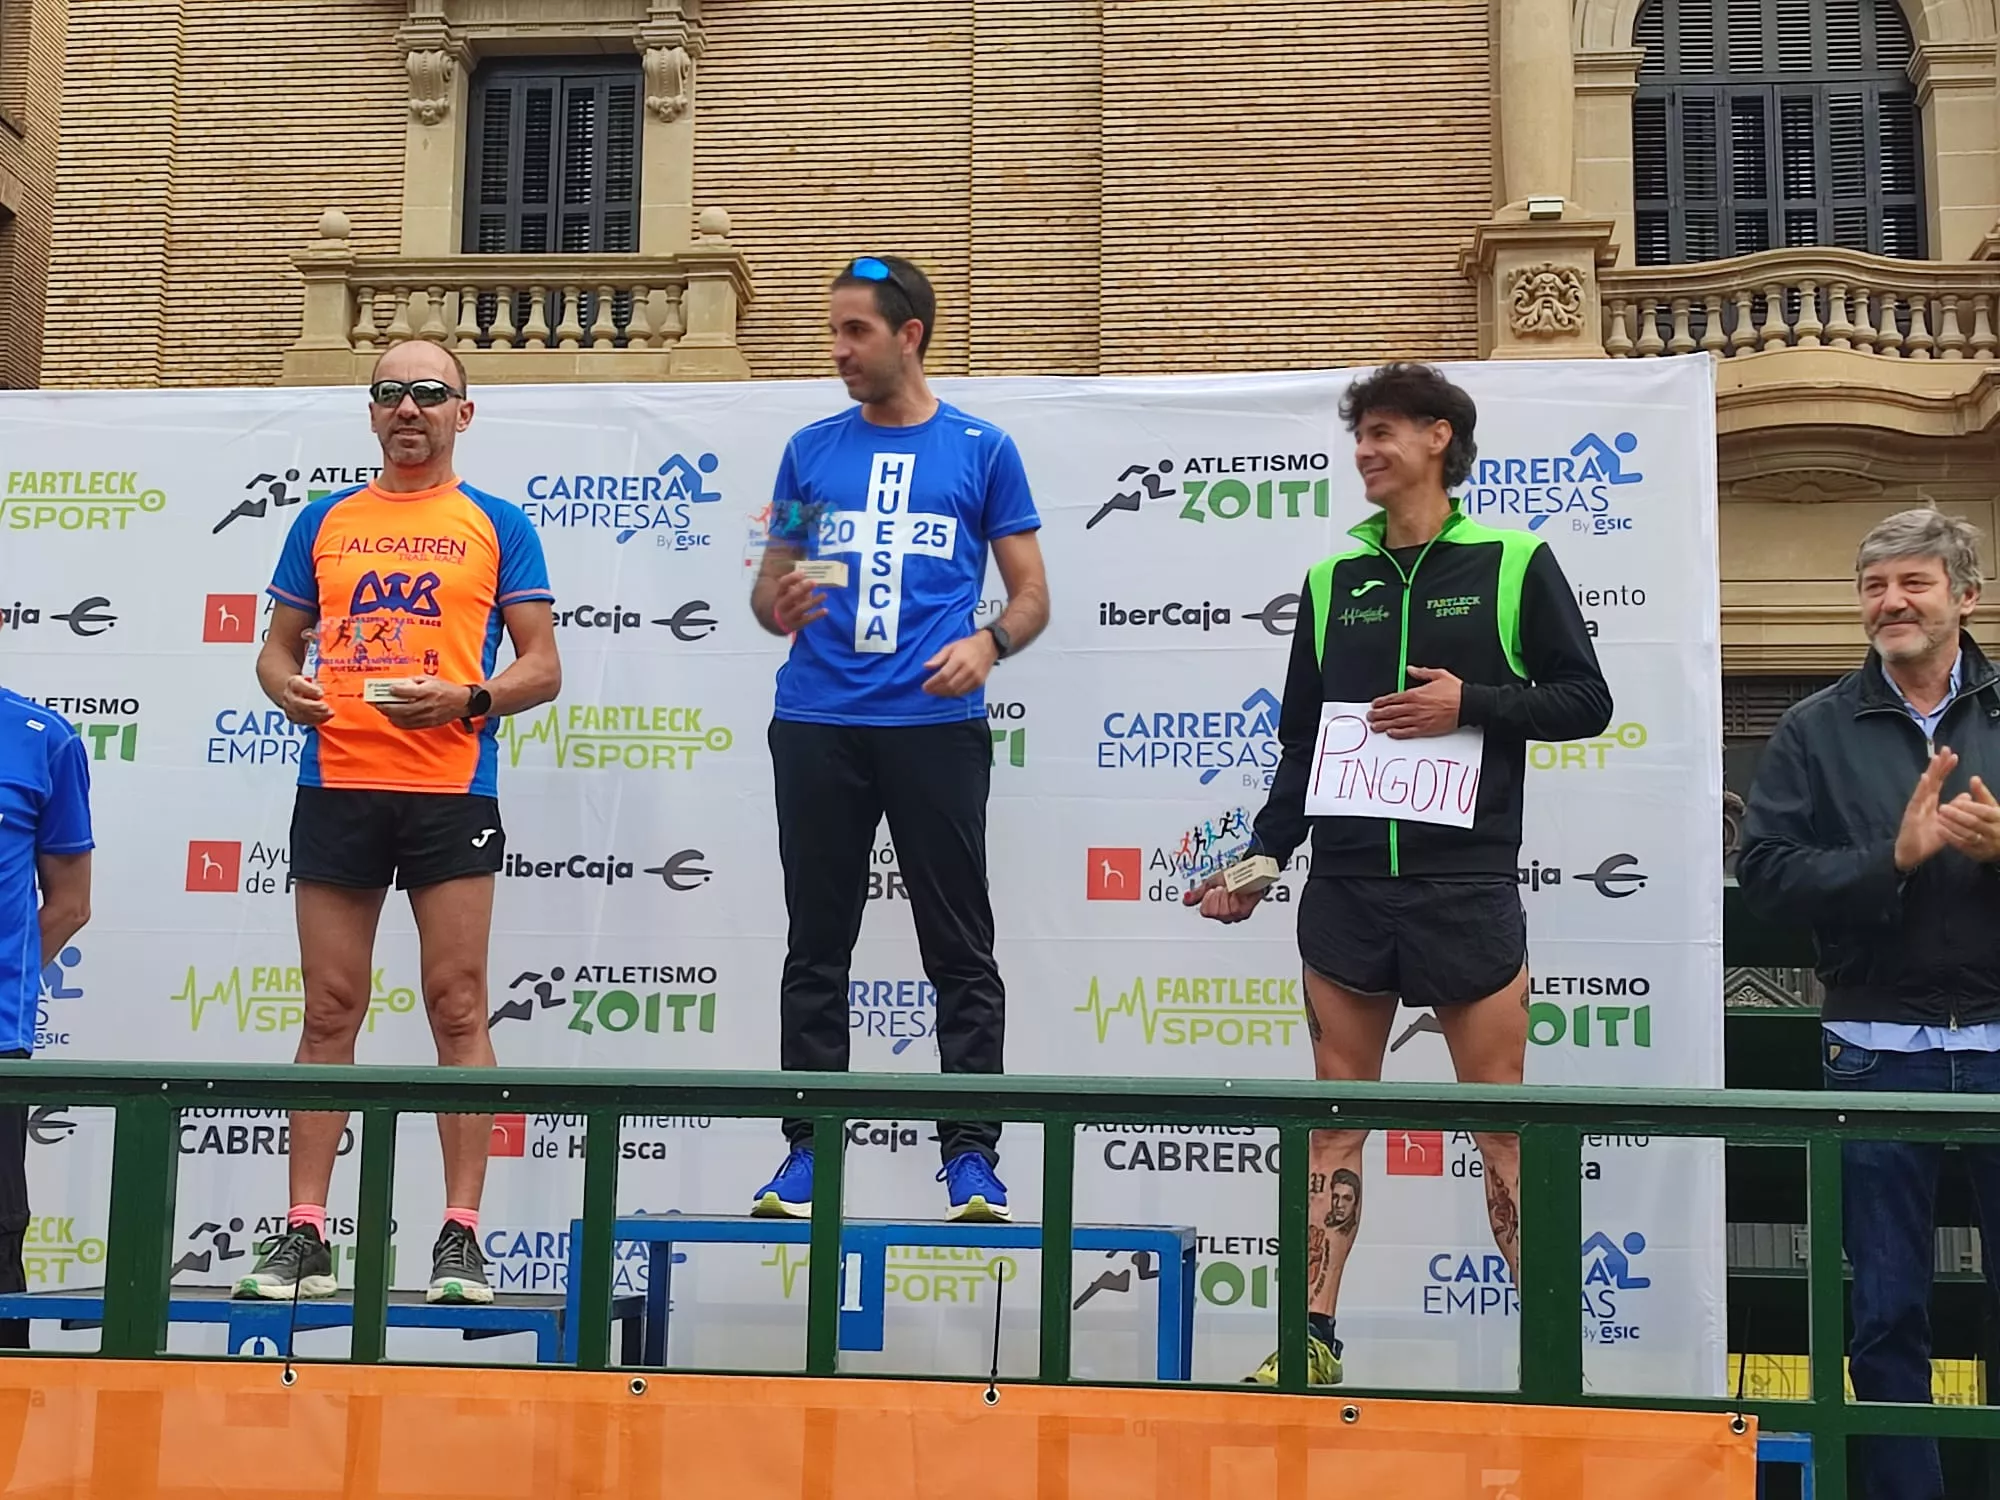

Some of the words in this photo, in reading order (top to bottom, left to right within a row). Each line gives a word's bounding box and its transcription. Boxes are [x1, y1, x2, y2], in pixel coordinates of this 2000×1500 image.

[309, 467, 381, 483] ATLET
[1184, 453, 1329, 474] ATLETISMO
[1465, 457, 1602, 486] RRERA
[7, 471, 138, 494] FARTLECK
[527, 475, 687, 501] CARRERA
[1179, 478, 1329, 523] ZOITI
[8, 506, 136, 530] SPORT
[1572, 519, 1590, 533] By
[346, 536, 467, 557] ALGAIRÉN
[656, 535, 673, 550] By
[820, 519, 856, 546] 20
[911, 521, 948, 548] 25
[863, 461, 904, 641] HUESCA
[1427, 596, 1481, 609] FARTLECK
[1435, 607, 1470, 618] SPORT
[1099, 601, 1231, 631] iberCaja
[569, 705, 703, 732] FARTLECK
[1103, 712, 1273, 738] CARRERA
[572, 743, 702, 770] SPORT
[1098, 741, 1278, 768] EMPRESAS
[1313, 714, 1479, 815] PINGOTU
[1528, 743, 1614, 770] ORT
[1242, 774, 1260, 789] By
[505, 854, 634, 885] iberCaja
[246, 872, 276, 894] de
[1149, 879, 1179, 901] de
[574, 966, 717, 984] ATLETISMO
[1530, 977, 1650, 996] LETISMO
[1156, 977, 1298, 1005] FARTLECK
[567, 990, 716, 1035] ZOITI
[1527, 1002, 1651, 1048] OITI
[1162, 1018, 1299, 1046] SPORT
[532, 1136, 559, 1159] de
[1451, 1153, 1484, 1178] de
